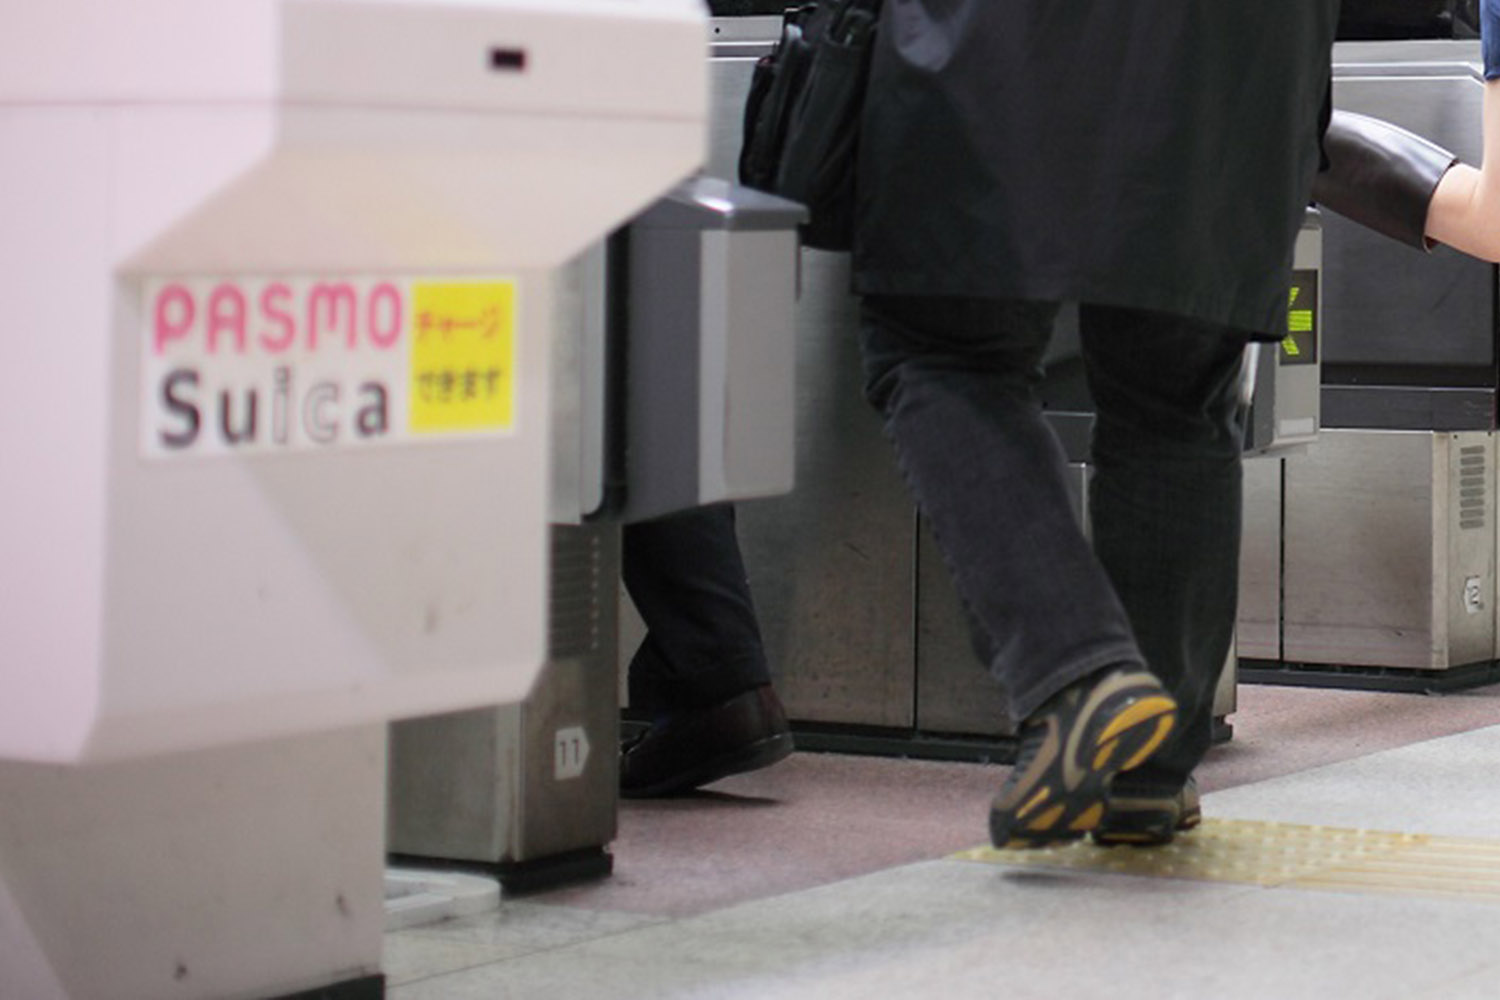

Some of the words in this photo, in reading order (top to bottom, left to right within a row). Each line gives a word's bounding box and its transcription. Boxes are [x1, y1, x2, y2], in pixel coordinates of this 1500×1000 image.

[153, 281, 404, 356] PASMO
[417, 305, 502, 341] チャージ
[157, 364, 391, 449] Suica
[559, 738, 580, 768] 11
